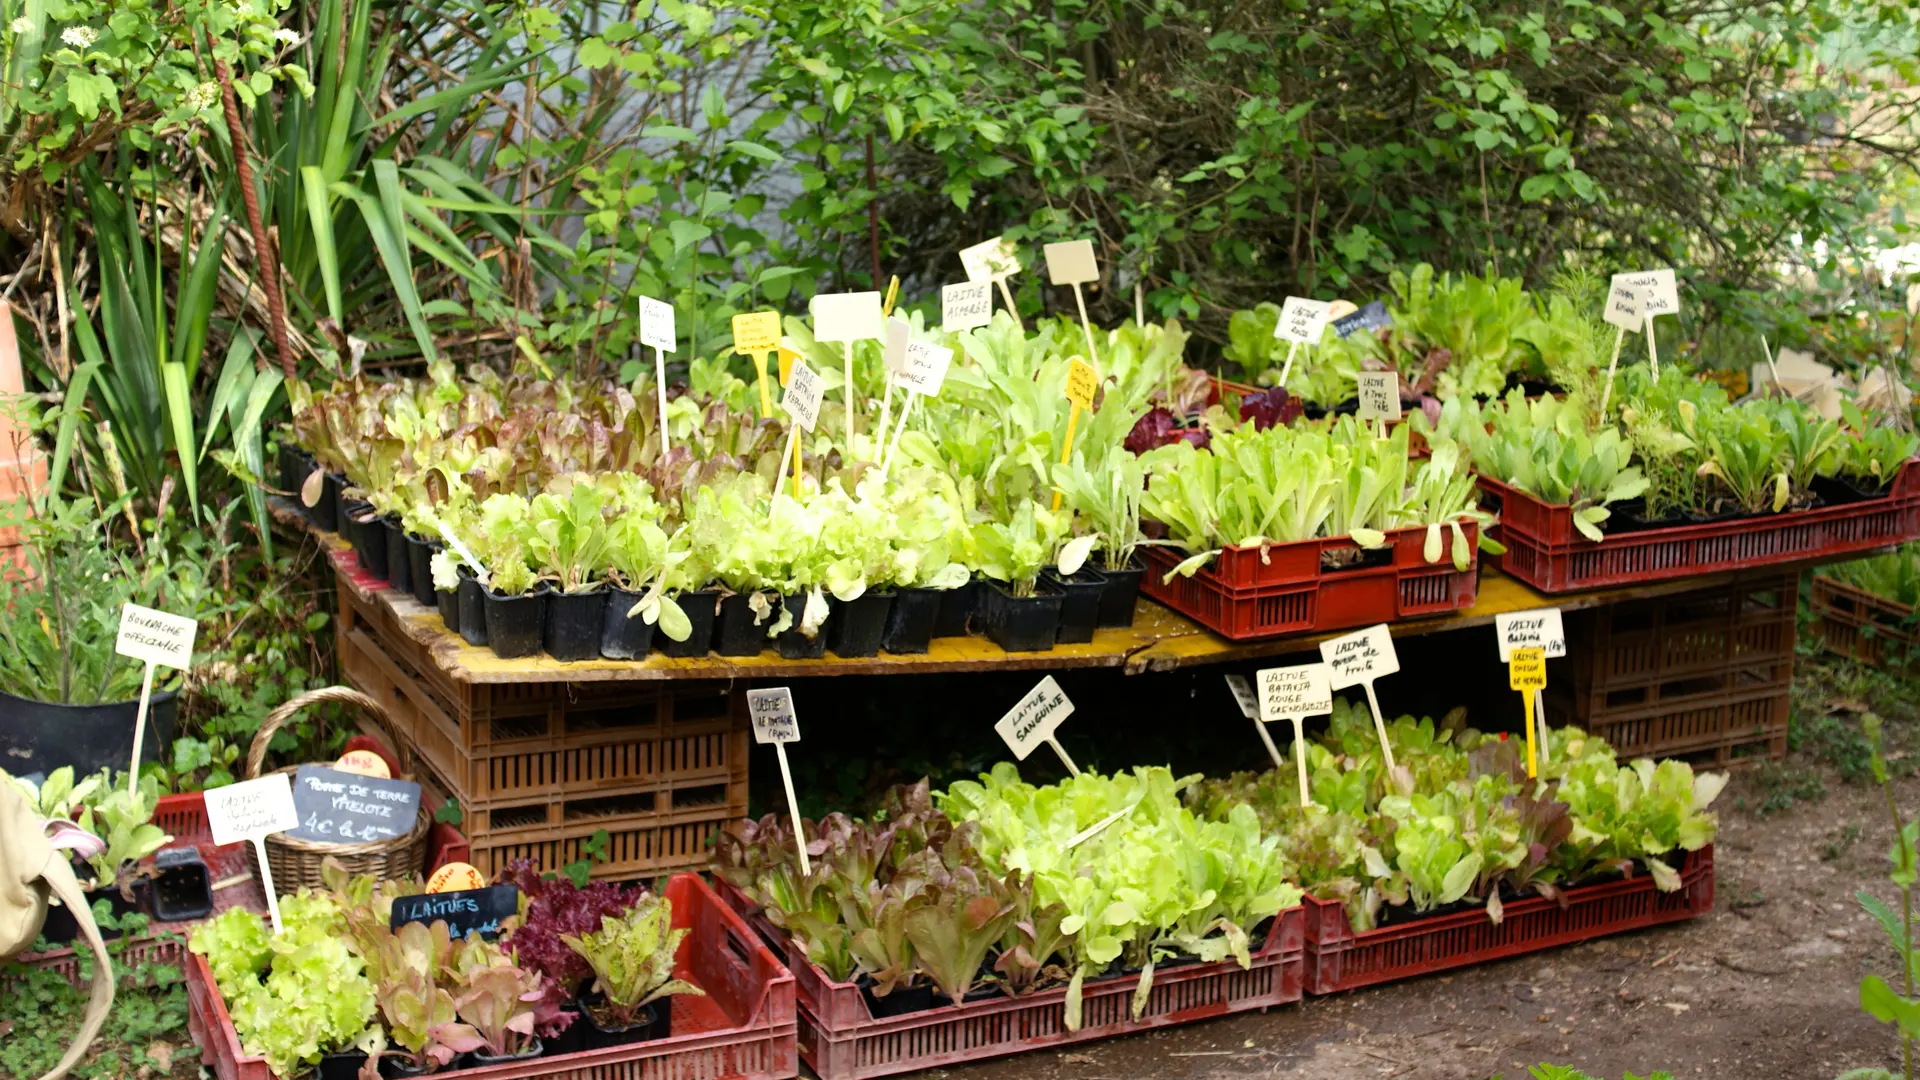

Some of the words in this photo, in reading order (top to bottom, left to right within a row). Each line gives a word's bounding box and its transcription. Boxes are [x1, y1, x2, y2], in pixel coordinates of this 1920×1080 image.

[1508, 617, 1545, 632] LAITUE
[1335, 636, 1369, 655] LAITUE
[1266, 671, 1308, 683] LAITUE
[1268, 681, 1311, 694] BATAVIA
[1012, 691, 1047, 727] LAITUE
[1268, 695, 1302, 704] ROUGE
[1016, 693, 1064, 742] SANGUINE
[349, 784, 370, 797] DE
[372, 789, 411, 804] TERRE
[410, 898, 480, 919] LAITUES
